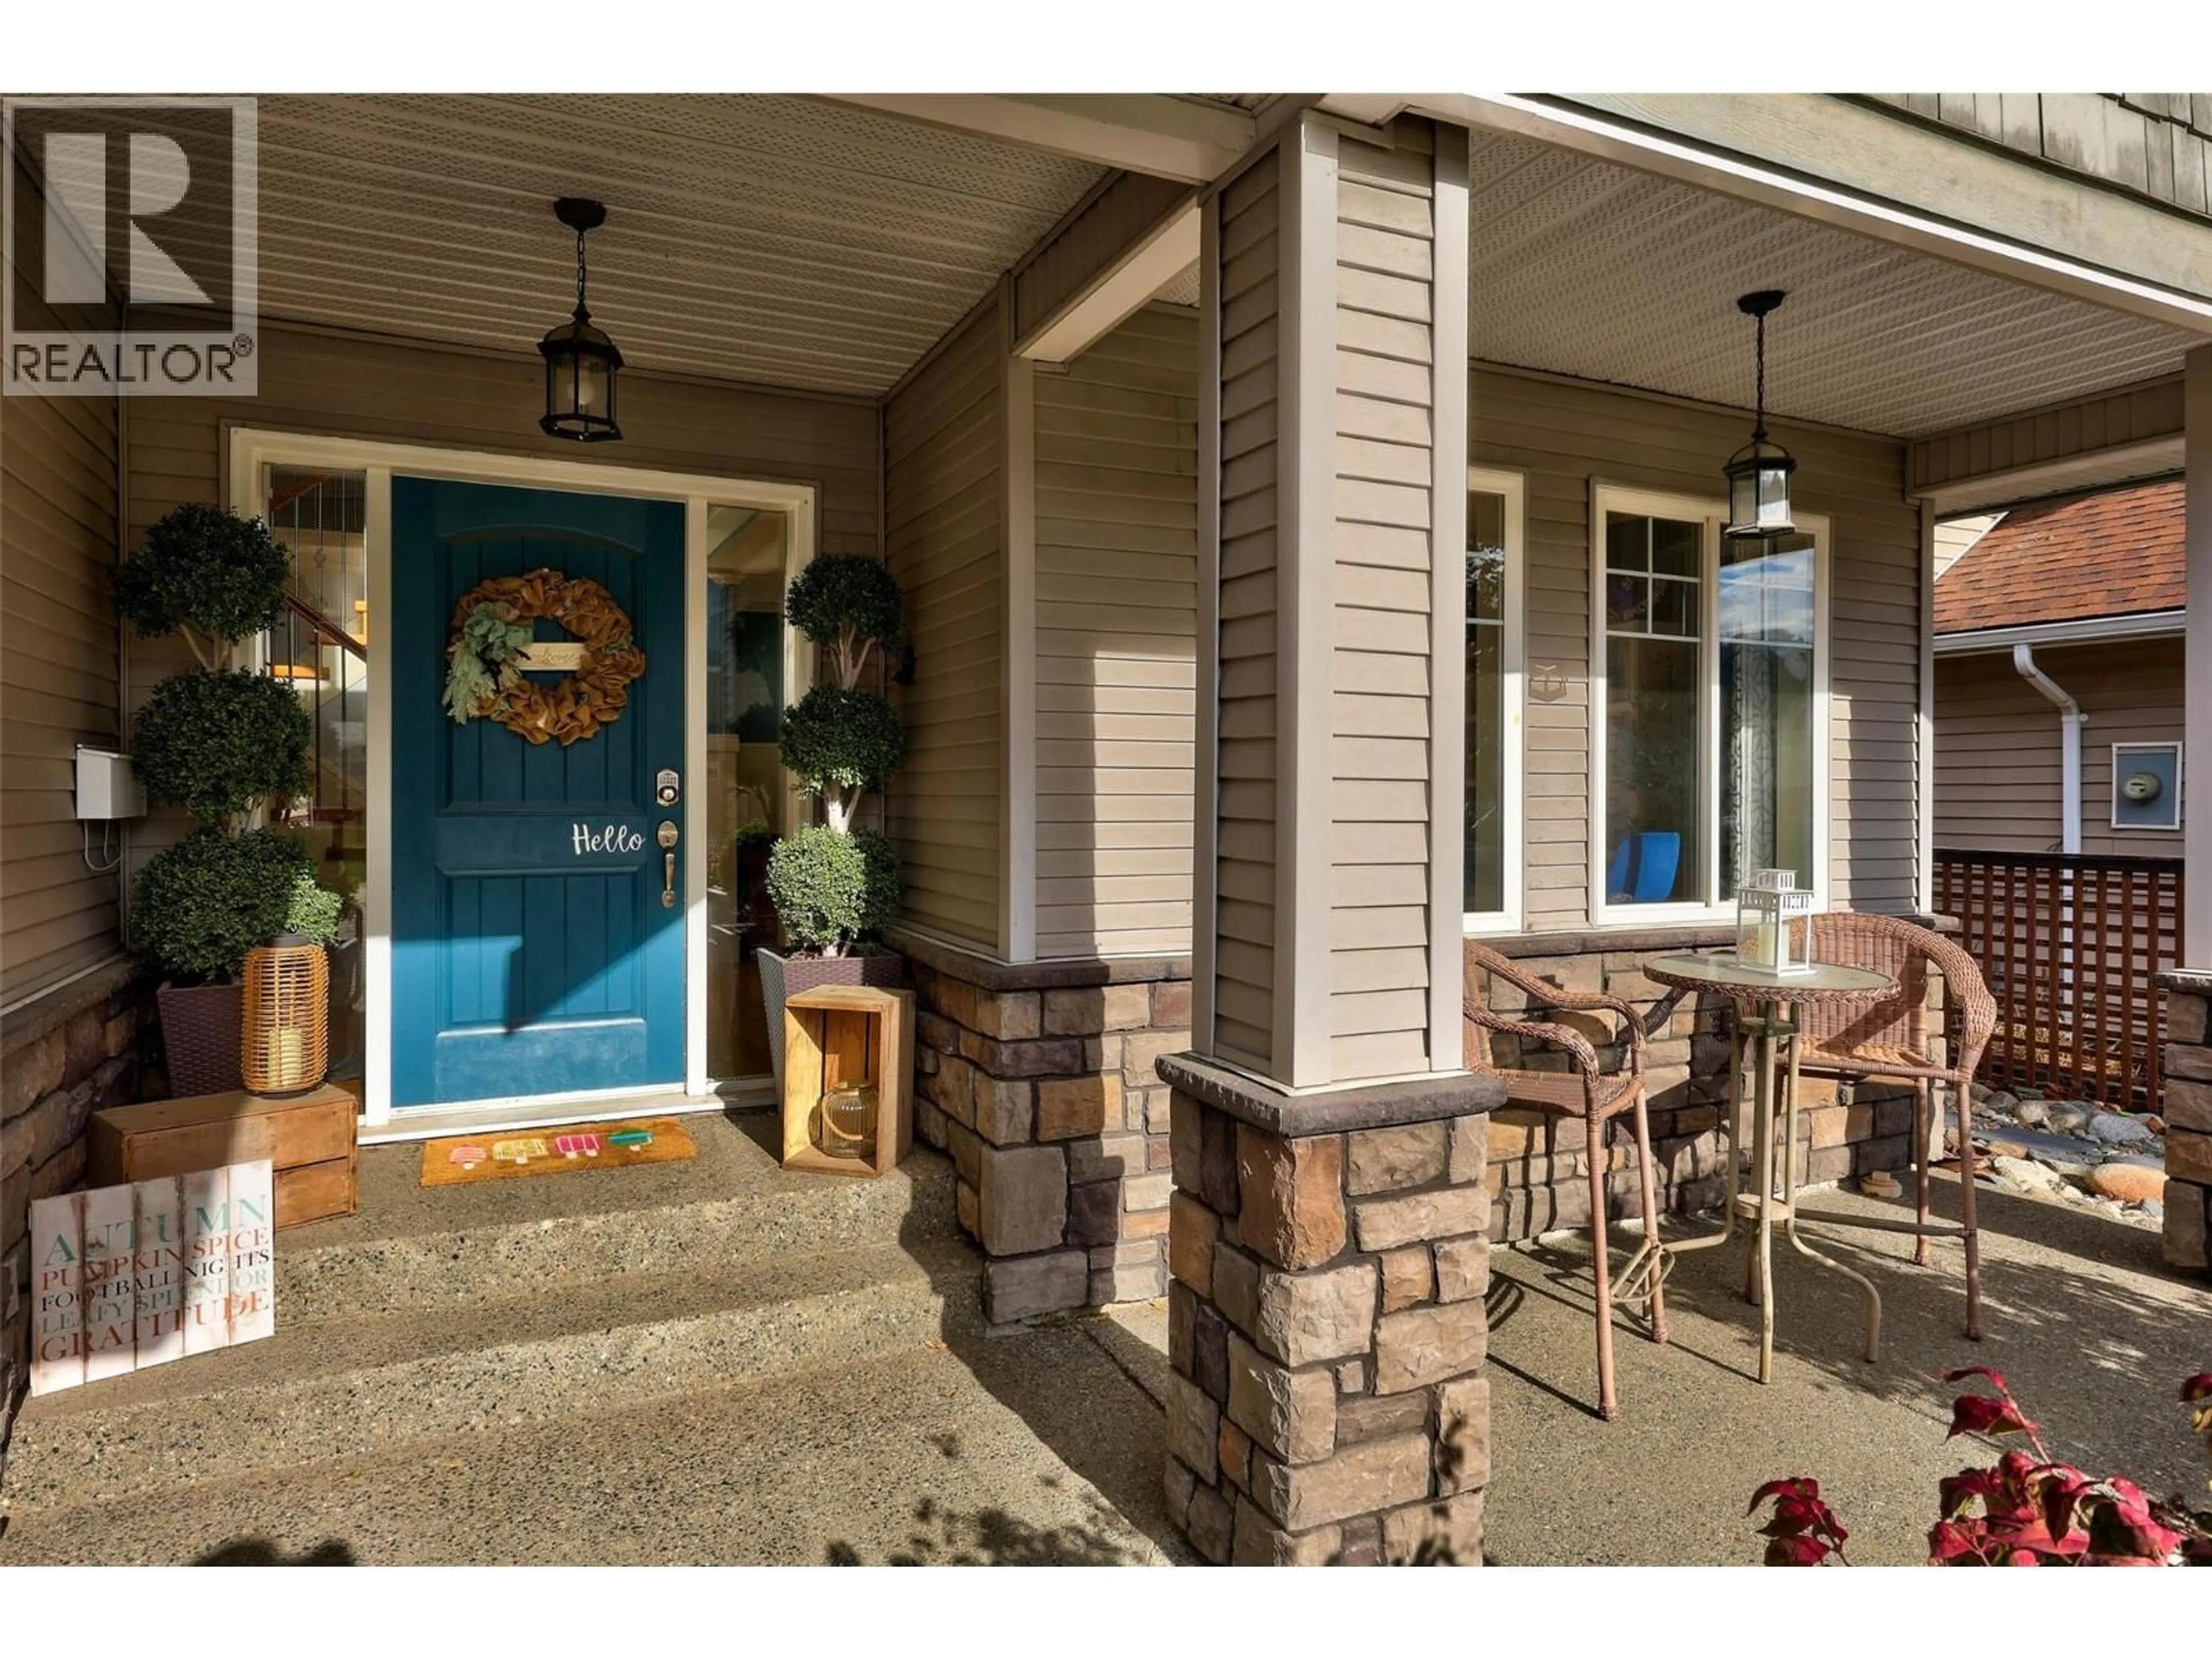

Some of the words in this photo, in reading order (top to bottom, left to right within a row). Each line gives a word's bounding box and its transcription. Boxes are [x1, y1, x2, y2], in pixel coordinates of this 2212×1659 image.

[571, 823, 646, 855] Hello
[41, 1247, 183, 1291] PUMPKIN
[193, 1228, 269, 1259] SPICE
[44, 1195, 266, 1266] AUTUMN
[42, 1270, 176, 1312] FOOTBALL
[183, 1249, 269, 1280] NIGHTS
[40, 1289, 269, 1362] GRATITUDE
[43, 1298, 127, 1334] LEAFY
